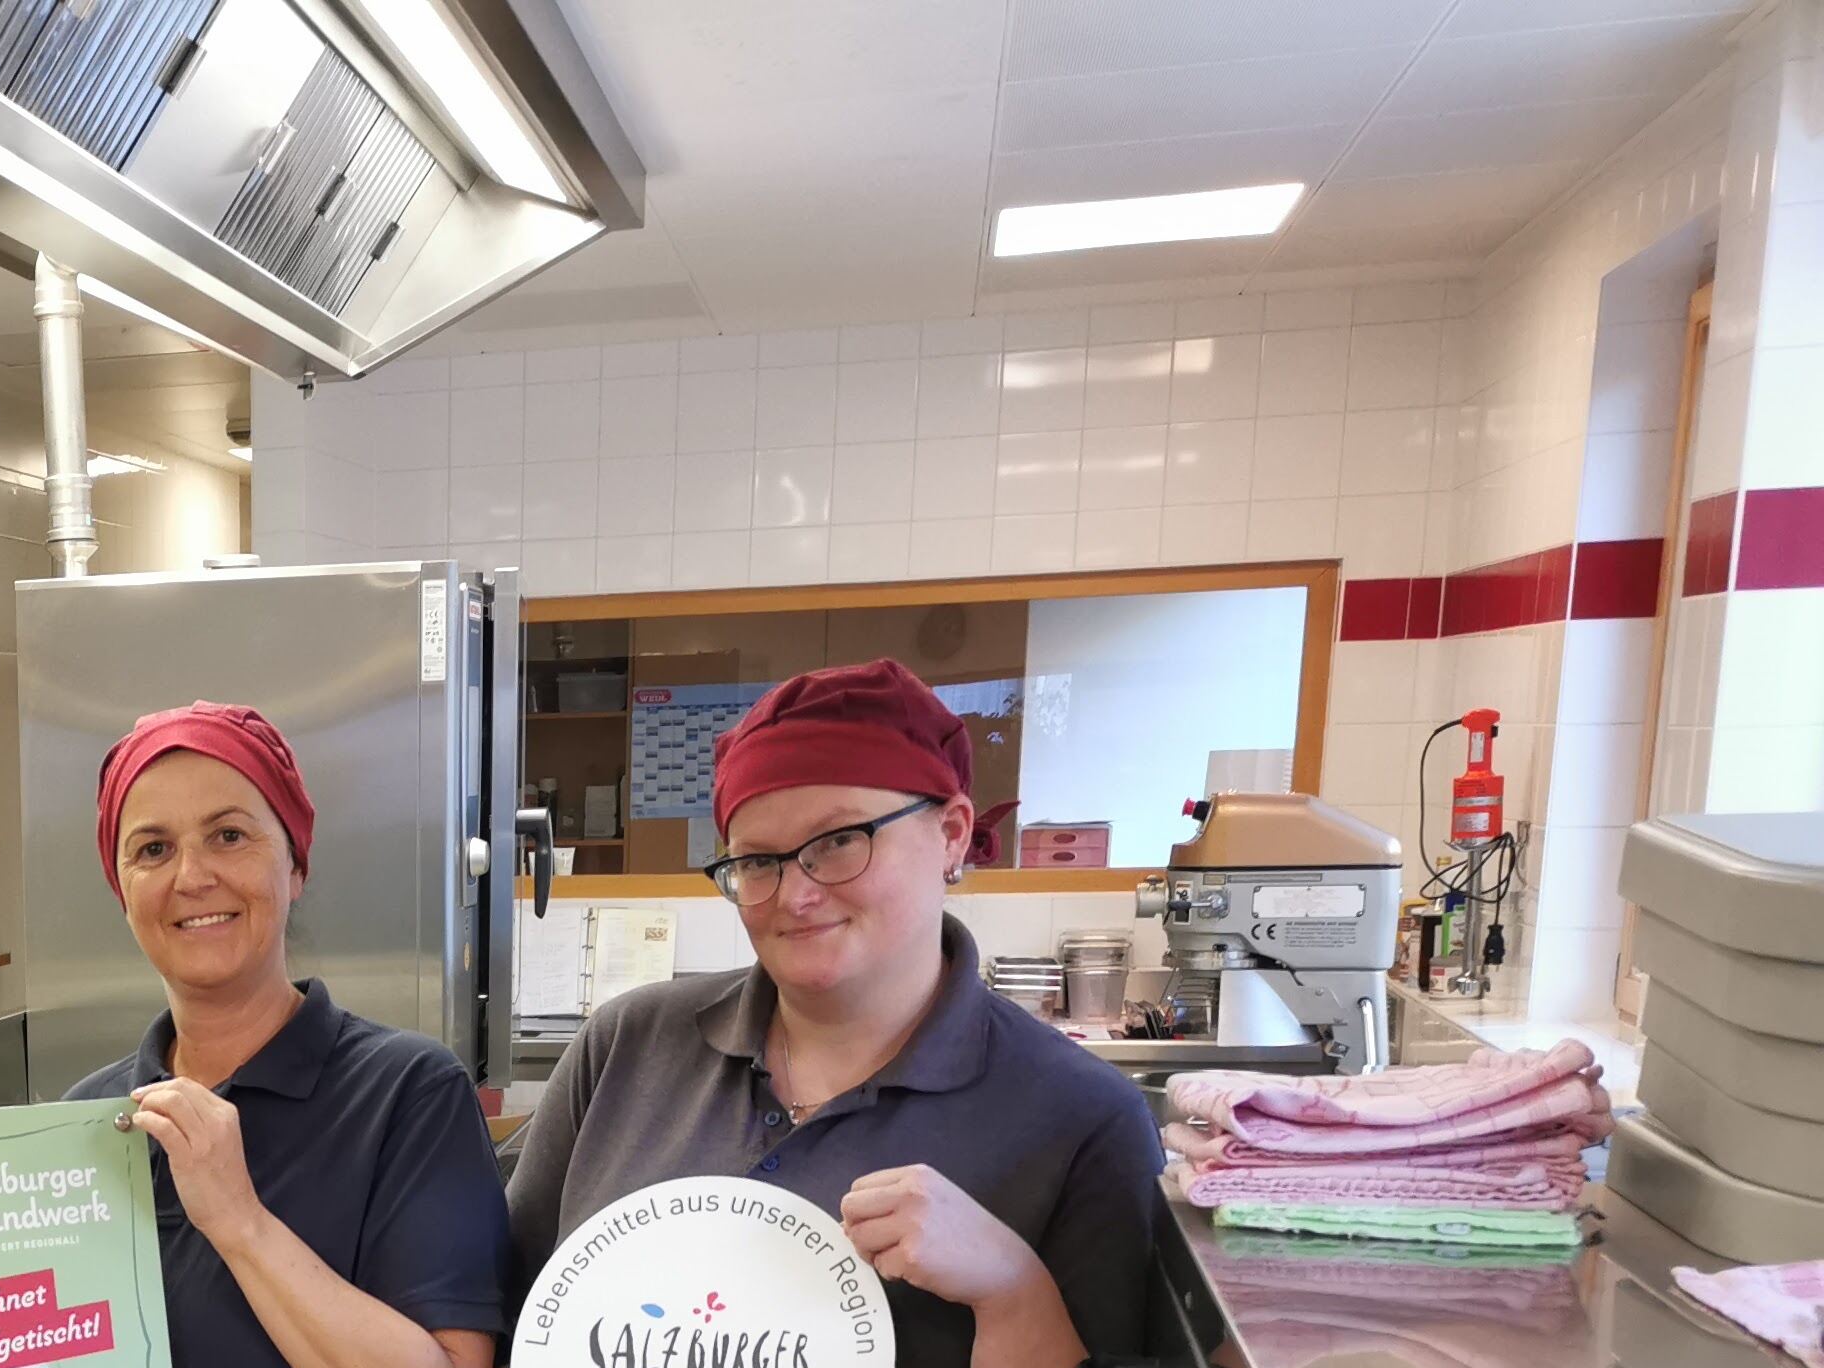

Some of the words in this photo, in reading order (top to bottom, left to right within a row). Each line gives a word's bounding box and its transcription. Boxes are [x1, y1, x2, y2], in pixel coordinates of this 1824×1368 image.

[23, 1235, 80, 1250] REGIONAL!
[524, 1198, 662, 1347] Lebensmittel
[669, 1193, 721, 1217] aus
[729, 1196, 835, 1259] unserer
[828, 1256, 879, 1355] Region
